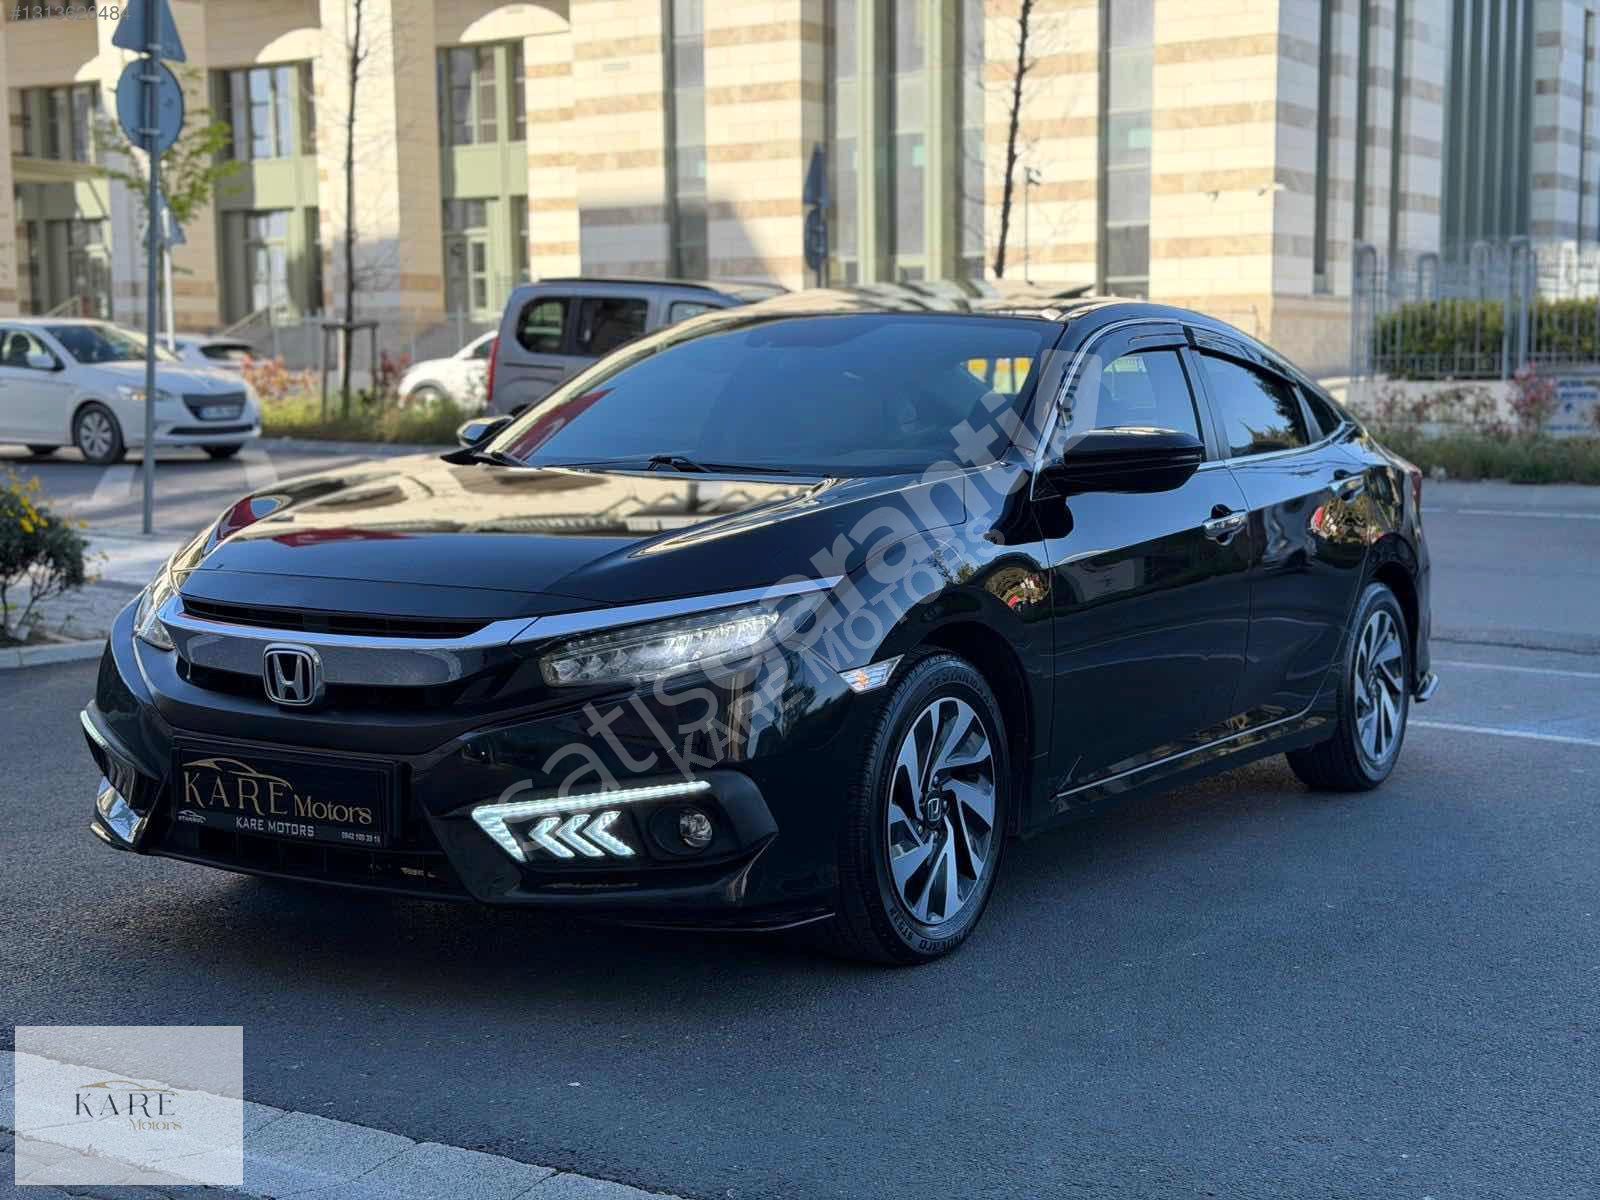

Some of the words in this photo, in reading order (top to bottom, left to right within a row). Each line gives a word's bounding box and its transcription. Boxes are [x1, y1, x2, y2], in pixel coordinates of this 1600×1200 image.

[183, 771, 288, 816] KARE
[294, 794, 373, 825] Motors
[236, 816, 264, 831] KARE
[267, 819, 315, 837] MOTORS
